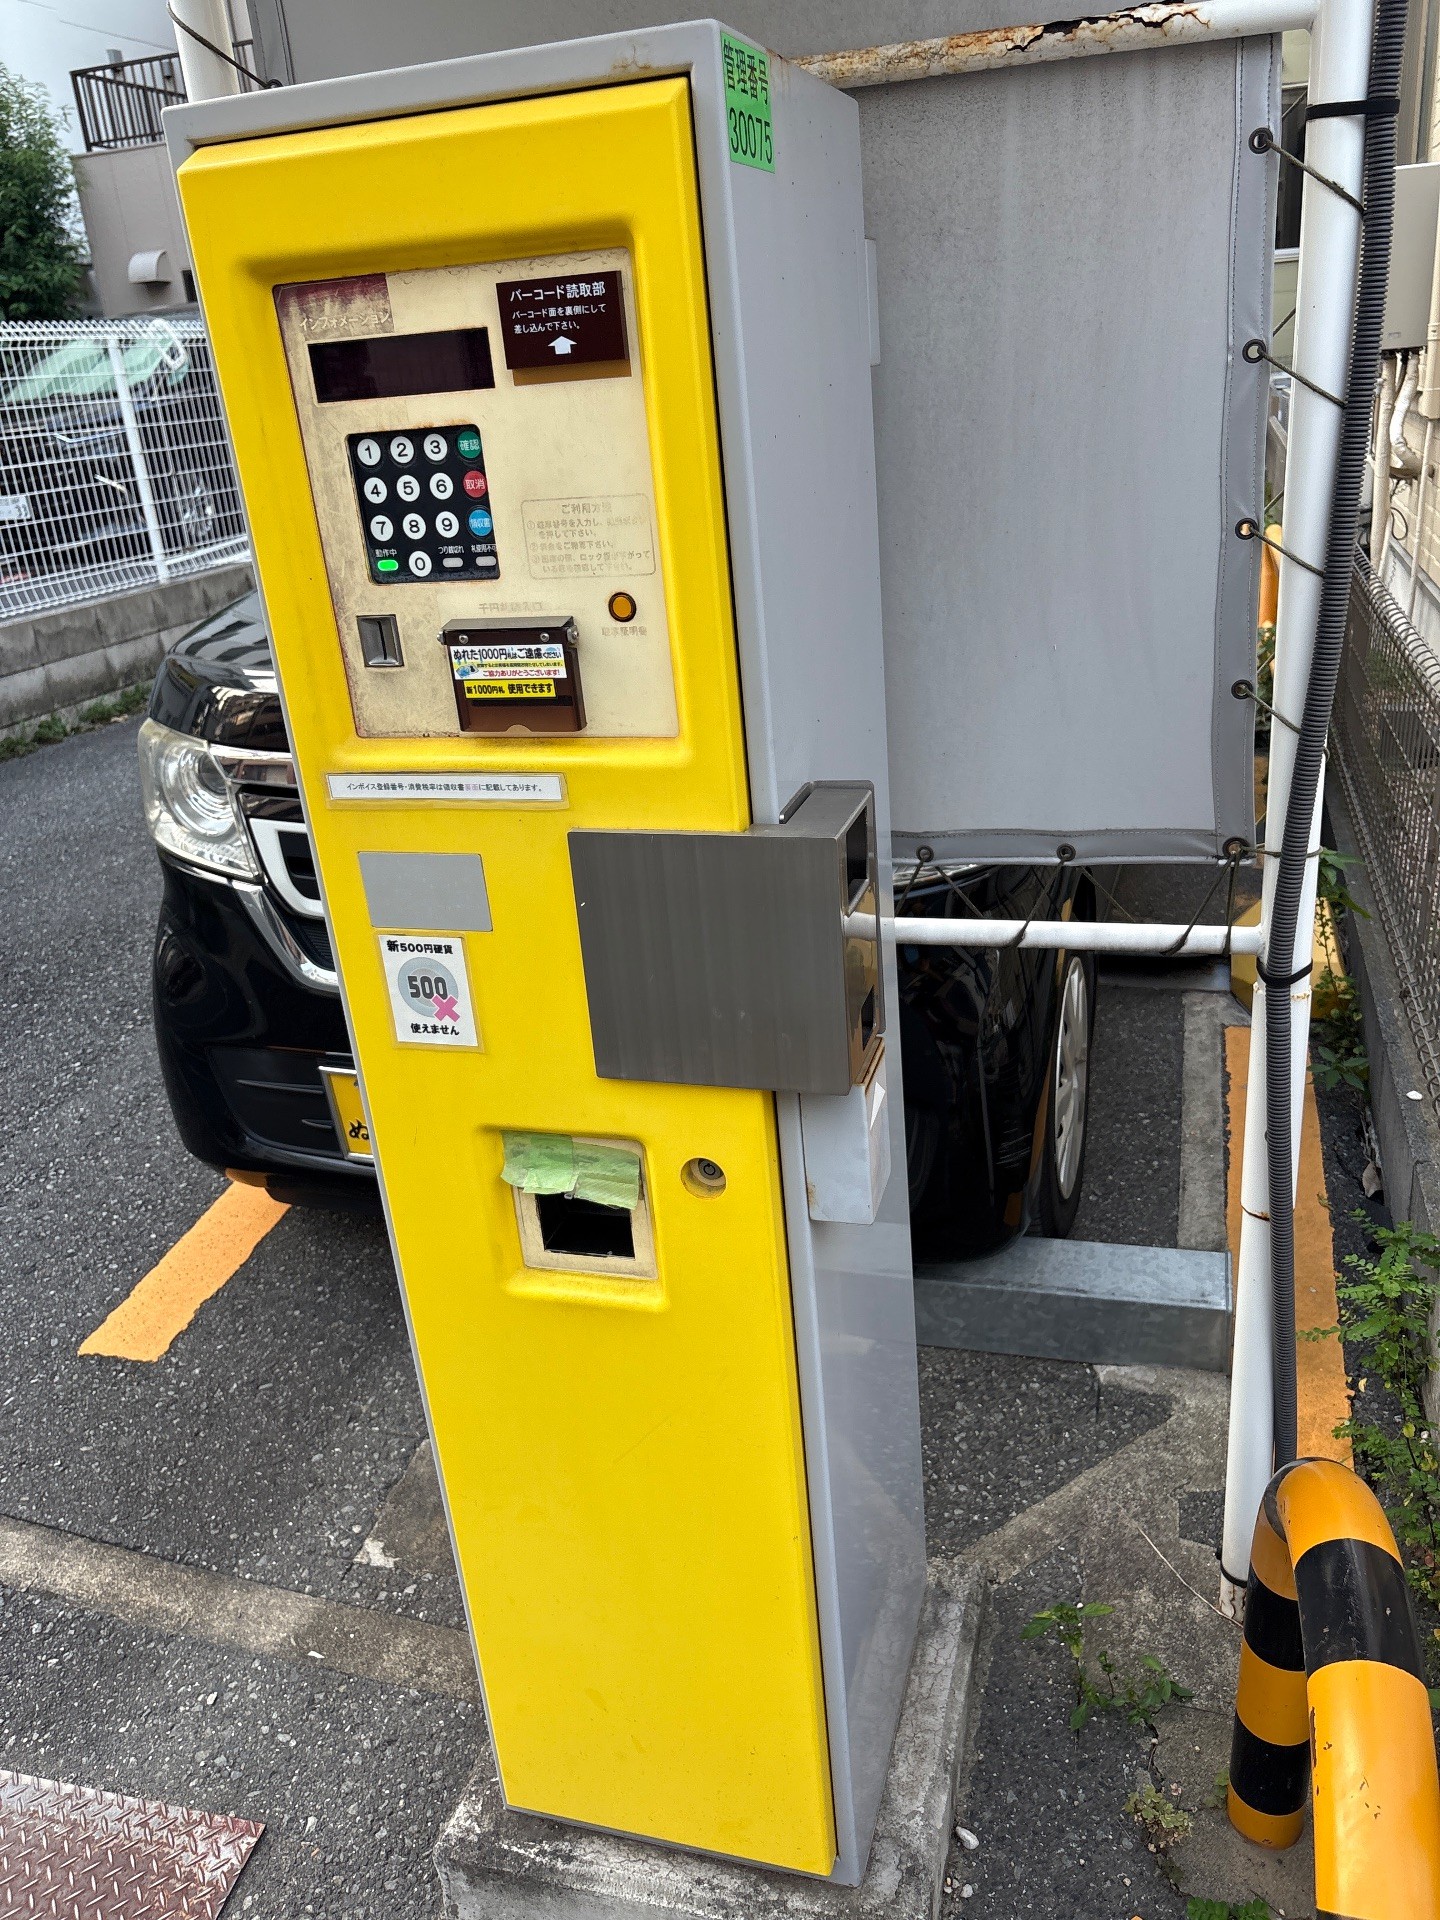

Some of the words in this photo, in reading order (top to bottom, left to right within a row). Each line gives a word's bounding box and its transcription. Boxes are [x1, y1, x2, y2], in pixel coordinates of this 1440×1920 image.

[723, 39, 768, 105] 管理番号
[729, 107, 773, 164] 30075
[510, 281, 606, 302] バーコード読取部
[512, 303, 607, 320] バーコード面を裏側にして
[300, 311, 391, 331] インフォメーション
[514, 321, 580, 334] 差し込んで下さい。
[364, 445, 372, 459] 1
[396, 442, 408, 457] 2
[430, 440, 441, 454] 3
[459, 439, 480, 451] 確認
[370, 484, 381, 497] 4
[403, 481, 414, 496] 5
[436, 479, 447, 493] 6
[464, 478, 486, 490] 取消
[376, 521, 387, 535] 7
[409, 519, 420, 534] 8
[442, 518, 452, 532] 9
[375, 548, 397, 558] 動作中
[414, 557, 426, 571] 0
[507, 682, 552, 694] 使用できます
[387, 939, 453, 955] 新500円硬貨
[407, 975, 448, 1000] 500
[411, 1022, 460, 1036] 使えません
